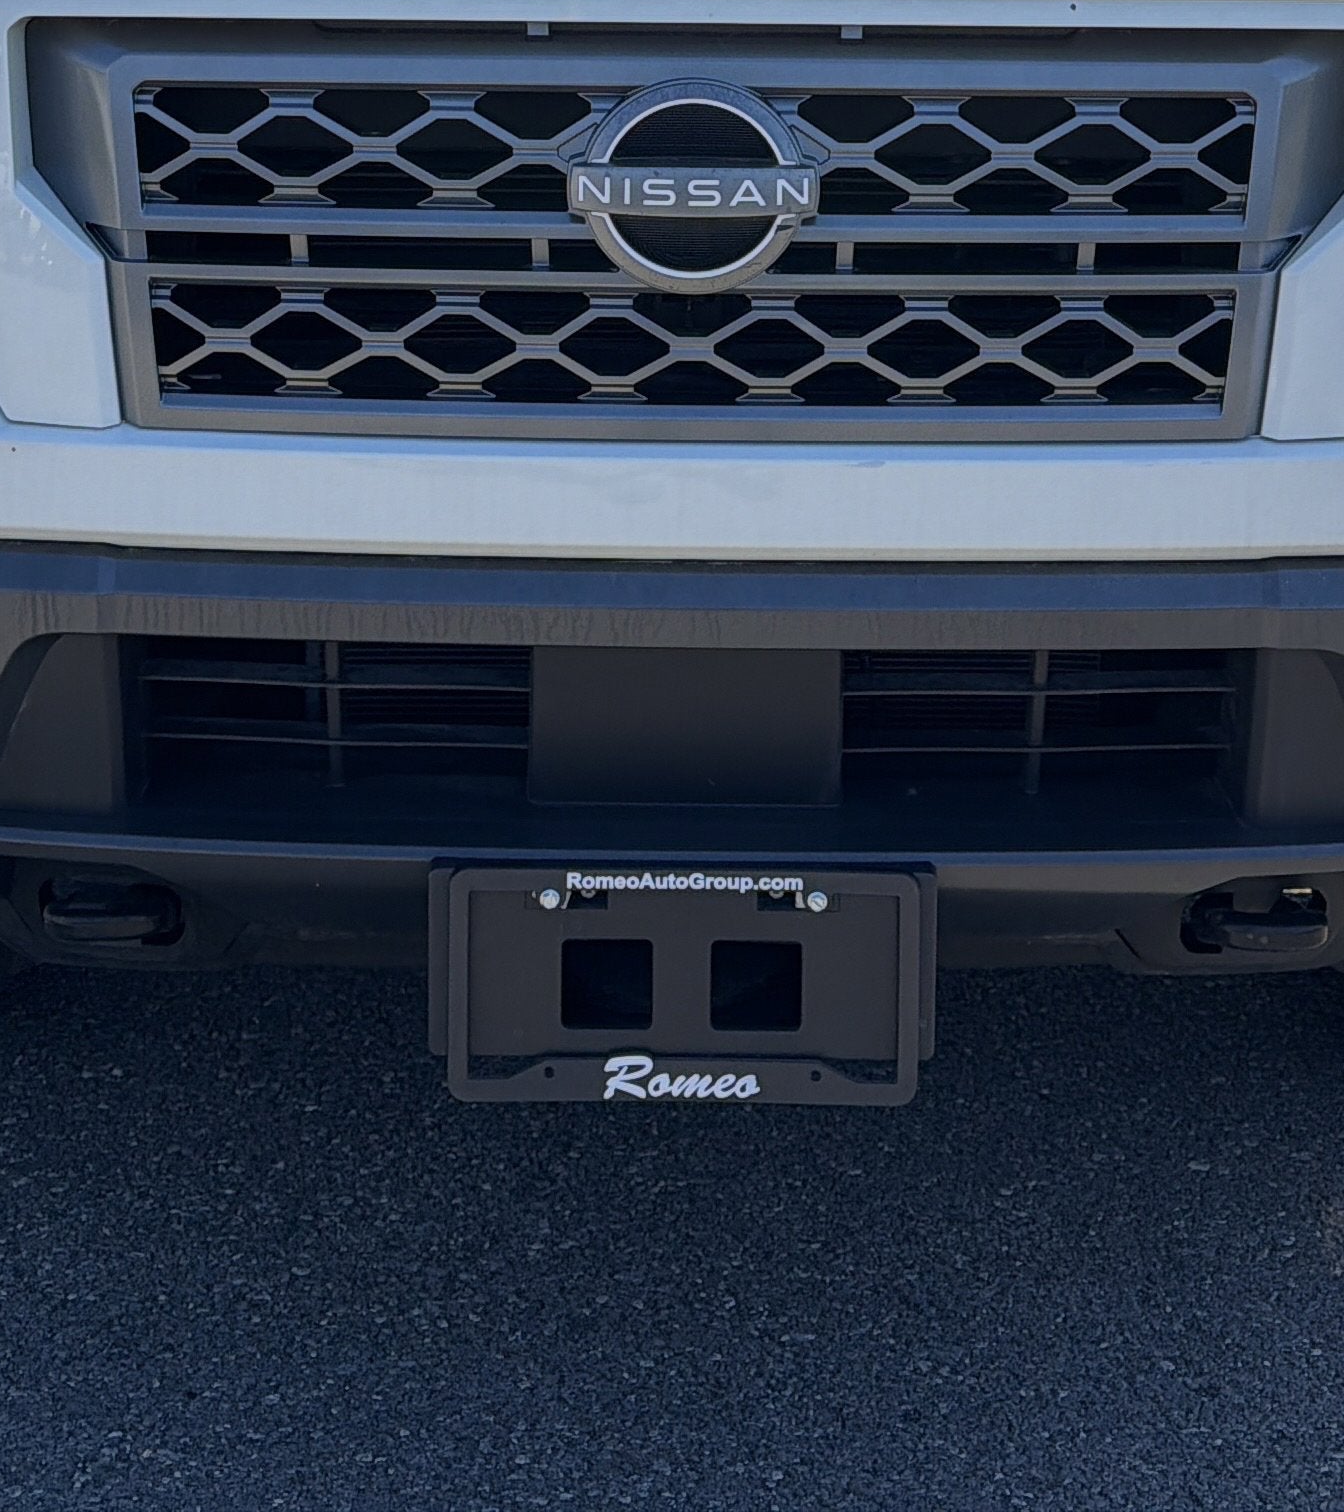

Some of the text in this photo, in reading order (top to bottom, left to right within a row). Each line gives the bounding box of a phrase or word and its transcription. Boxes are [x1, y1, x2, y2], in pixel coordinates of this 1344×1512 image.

[577, 173, 810, 208] NISSAN
[566, 871, 804, 894] RomeoAutoGroup.com
[602, 1055, 761, 1100] Romeo
